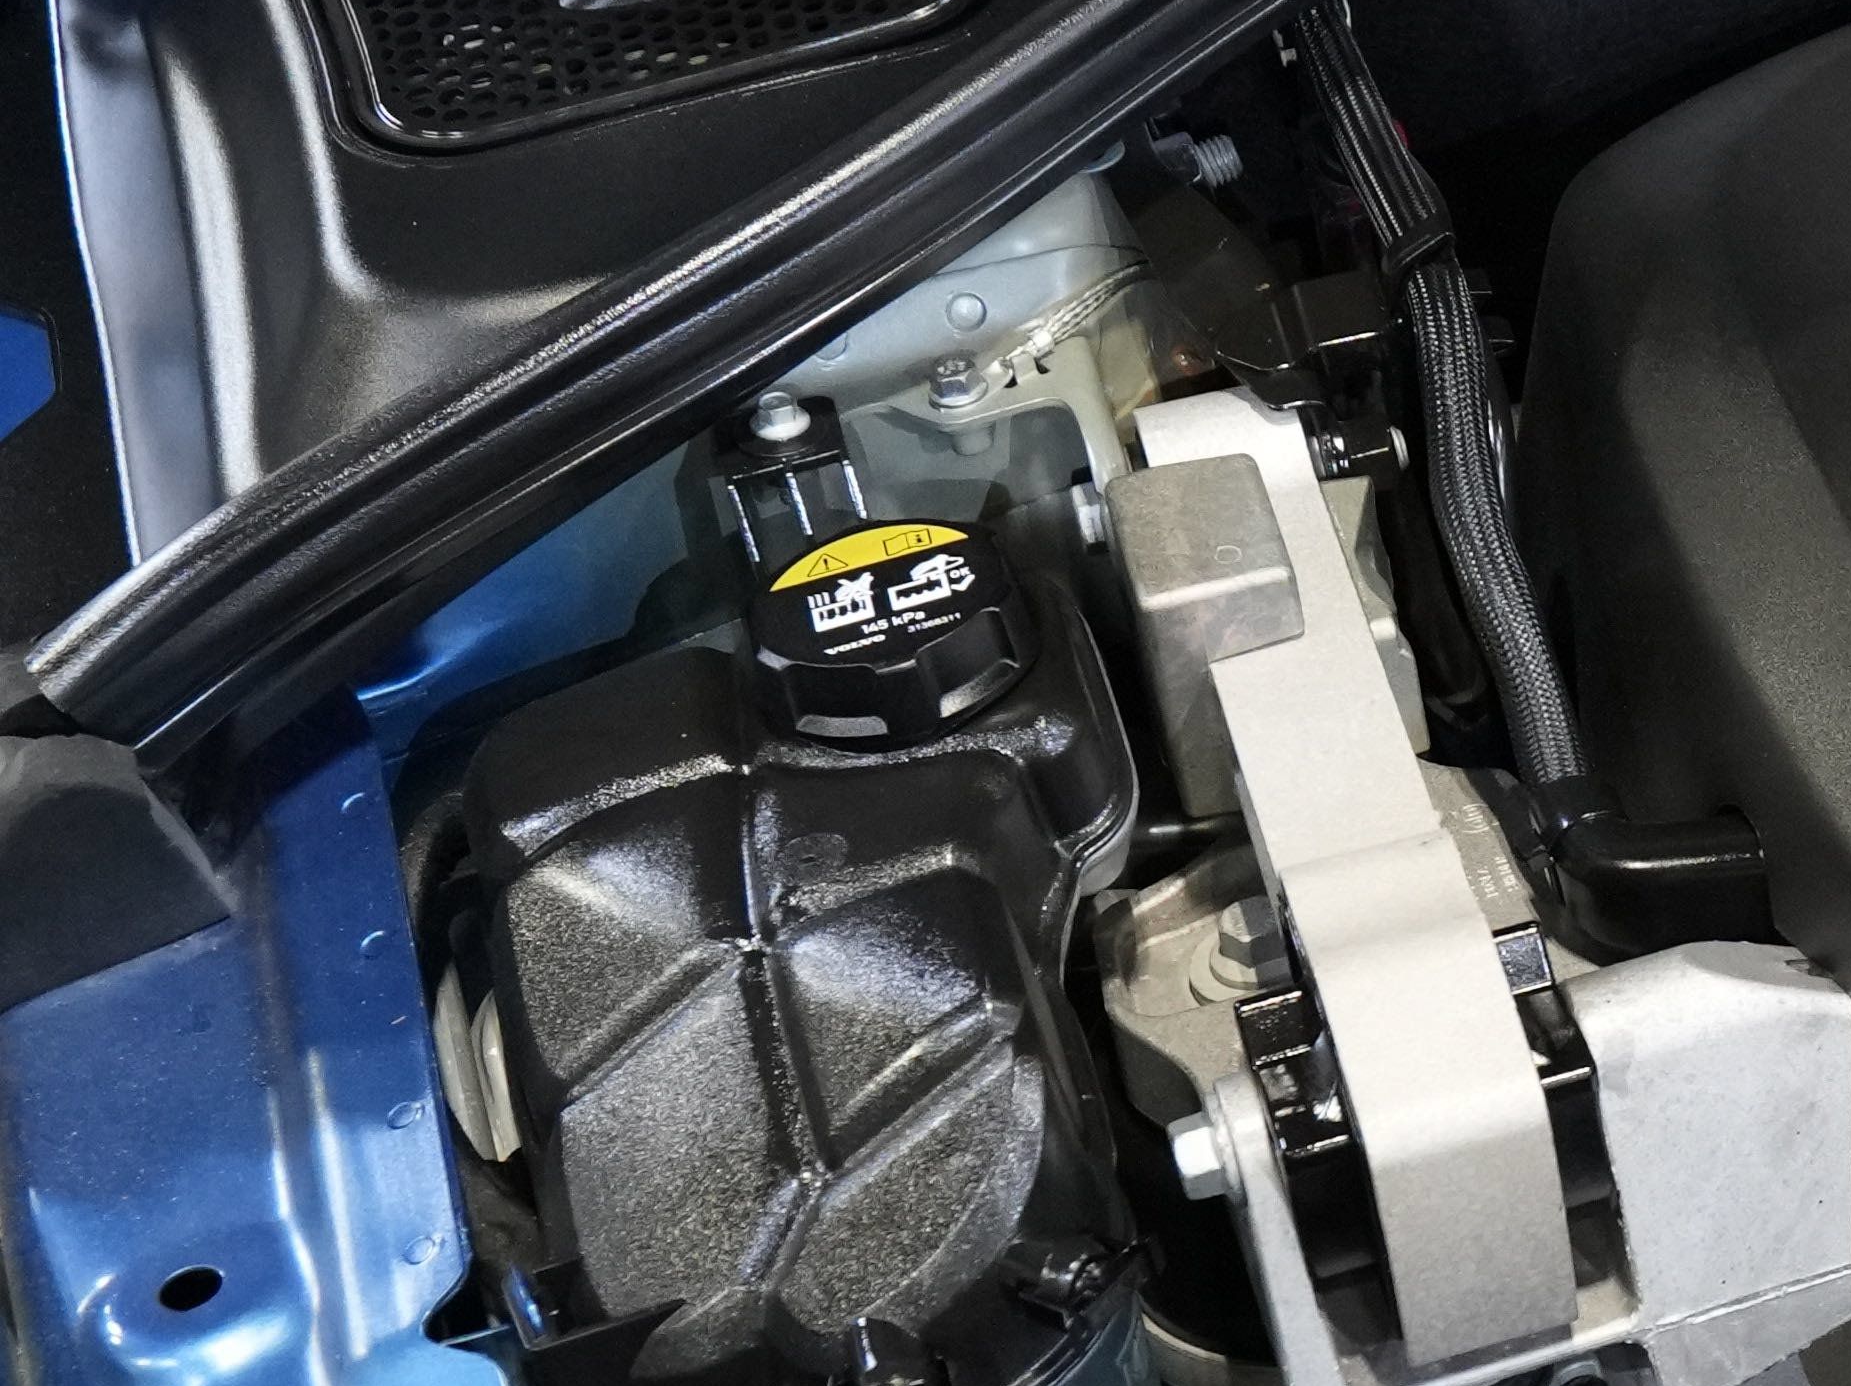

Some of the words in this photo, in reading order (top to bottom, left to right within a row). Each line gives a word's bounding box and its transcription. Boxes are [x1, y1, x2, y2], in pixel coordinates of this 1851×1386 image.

[949, 566, 971, 580] OK
[861, 618, 890, 635] 145
[891, 609, 926, 627] kPa
[823, 634, 887, 656] VOLVO
